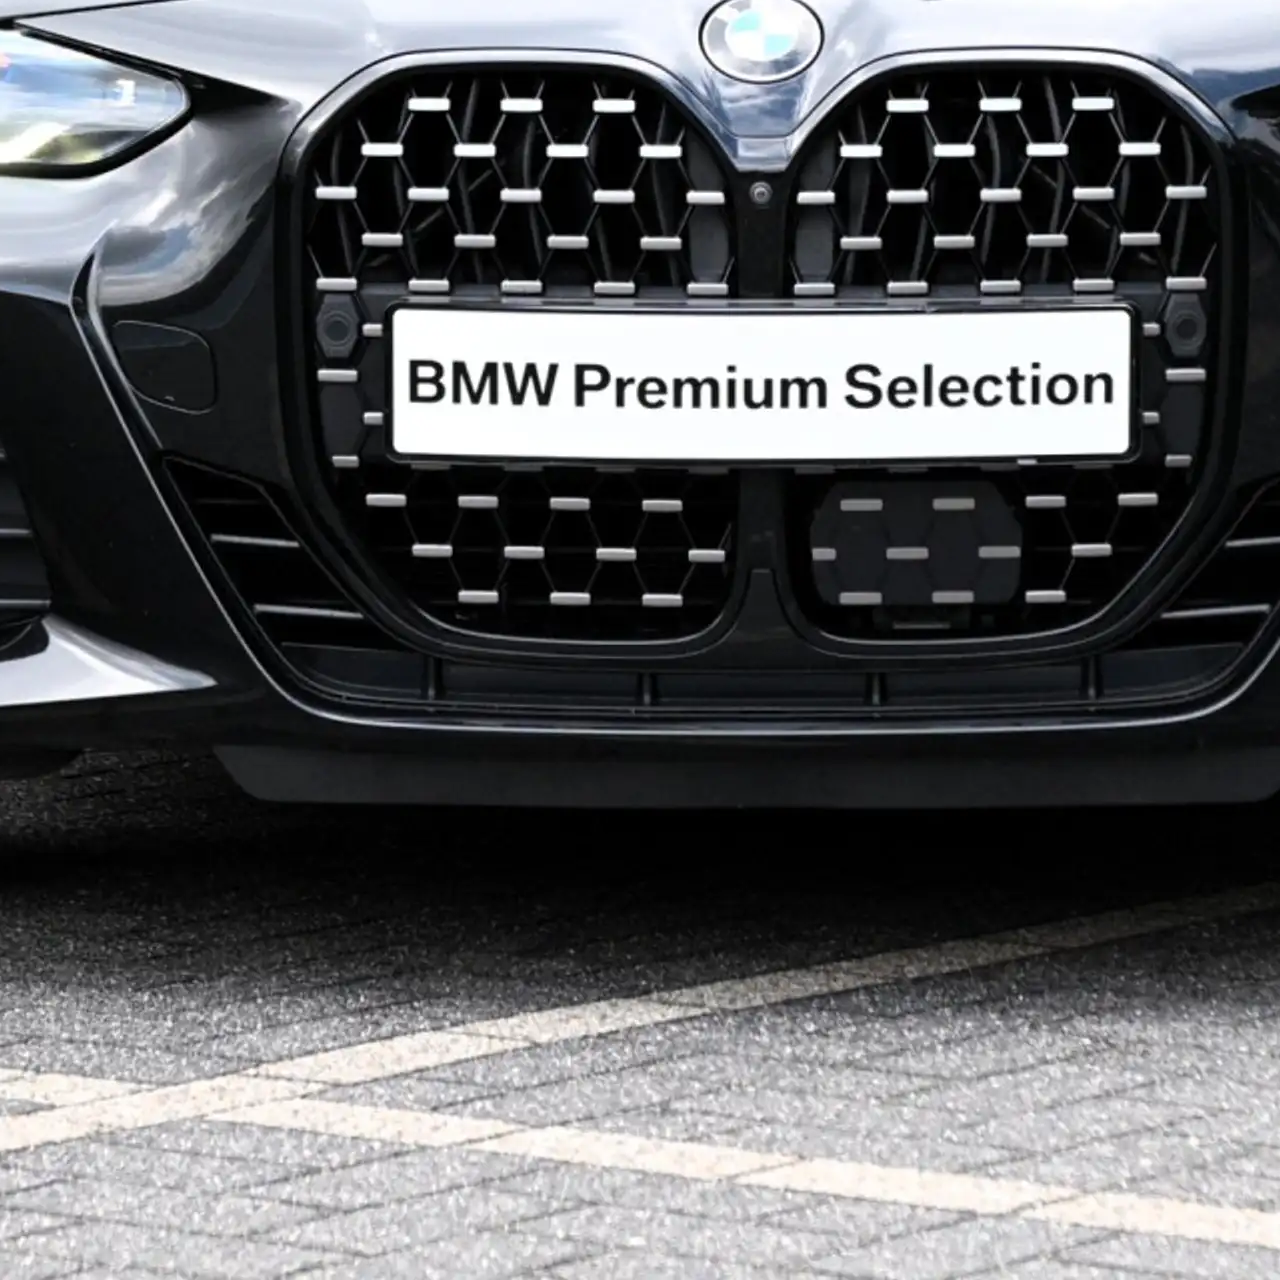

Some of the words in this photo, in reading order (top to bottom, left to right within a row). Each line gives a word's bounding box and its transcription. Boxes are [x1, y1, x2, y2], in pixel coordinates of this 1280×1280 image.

[408, 358, 559, 406] BMW
[573, 363, 828, 409] Premium
[843, 362, 1114, 409] Selection
